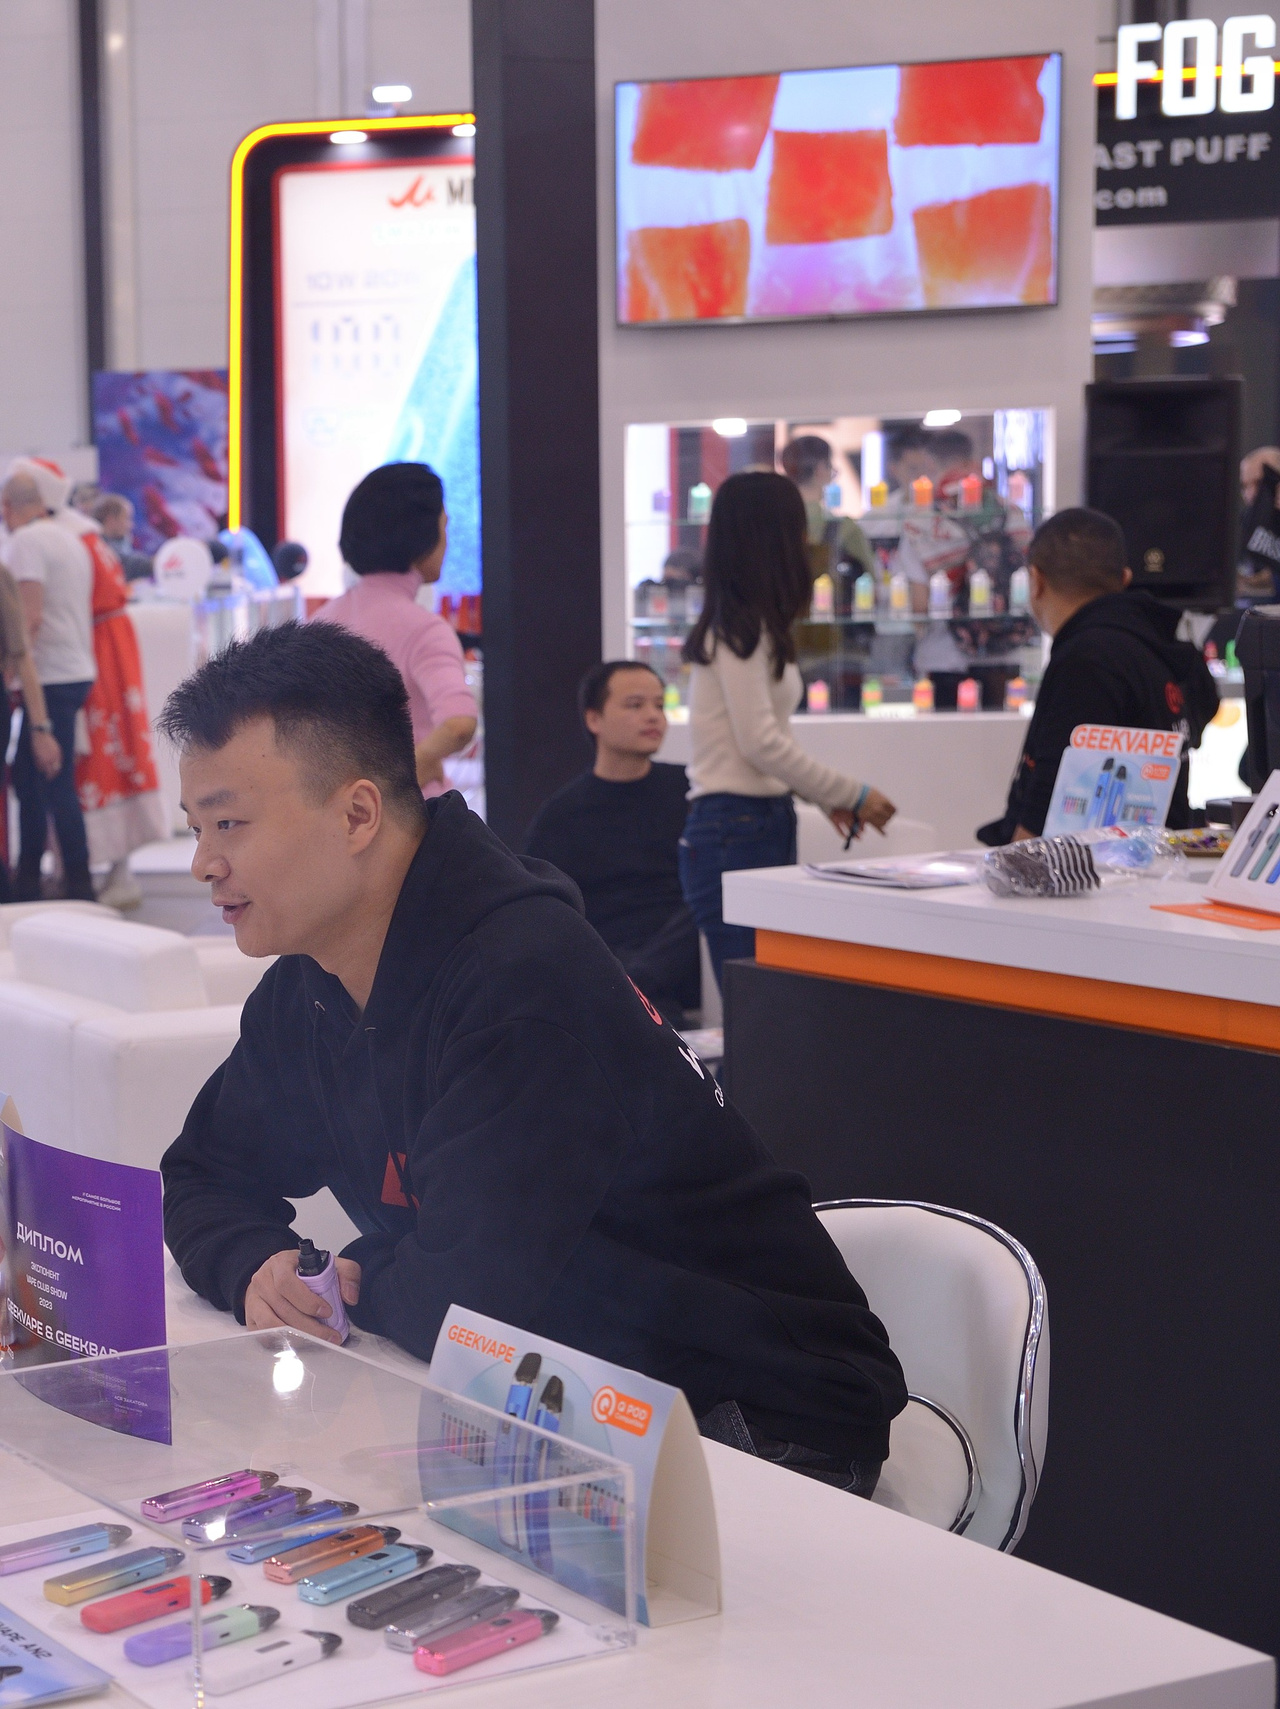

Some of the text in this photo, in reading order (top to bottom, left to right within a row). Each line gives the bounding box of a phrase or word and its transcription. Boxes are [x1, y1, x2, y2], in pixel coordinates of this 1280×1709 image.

[1115, 14, 1277, 120] FOG
[1170, 132, 1271, 166] PUFF
[1072, 725, 1178, 757] GEEKVAPE
[16, 1221, 84, 1265] ДИПЛОМ
[37, 1280, 50, 1293] CLUB
[50, 1286, 68, 1300] SHOW
[39, 1297, 53, 1311] 2023
[6, 1297, 44, 1336] GEEKVAPE
[45, 1325, 54, 1340] &
[448, 1325, 516, 1363] GEEKVAPE
[626, 1404, 648, 1421] POD
